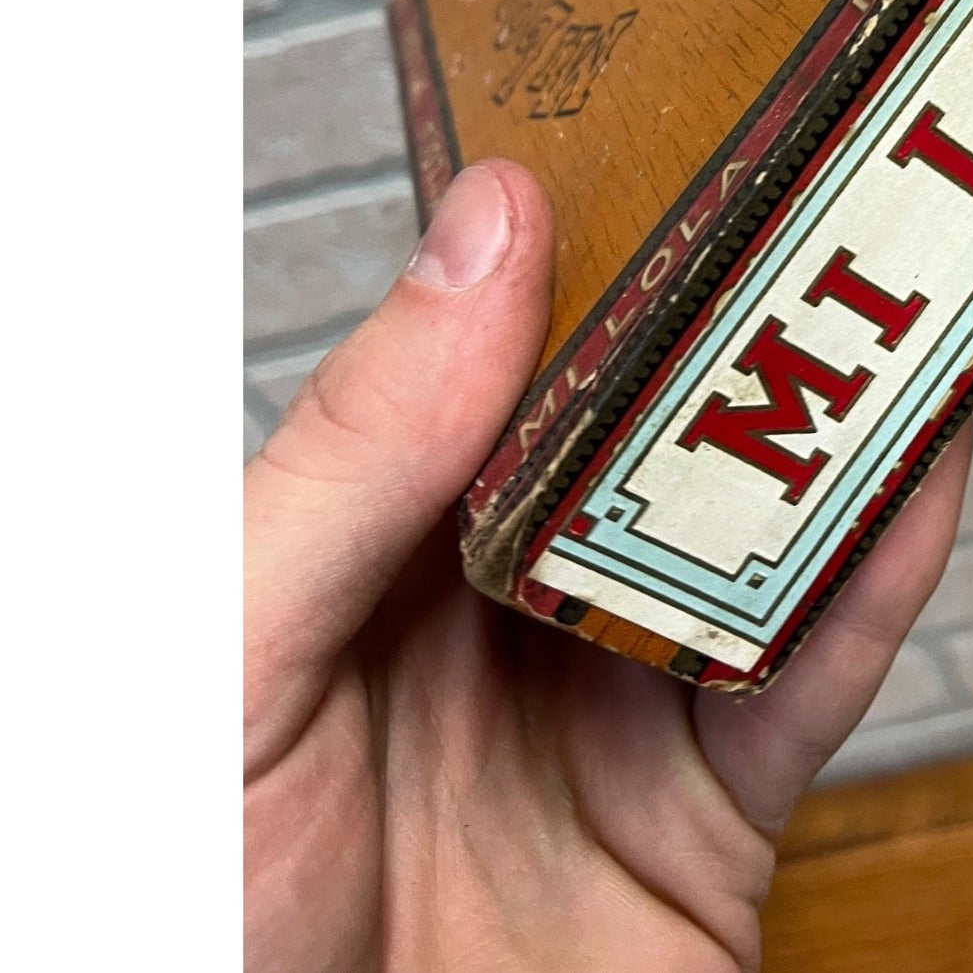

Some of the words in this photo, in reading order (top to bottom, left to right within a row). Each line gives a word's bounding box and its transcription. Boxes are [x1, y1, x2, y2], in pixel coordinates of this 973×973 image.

[518, 365, 597, 460] MI
[602, 158, 749, 340] LOLA
[676, 246, 931, 506] MI
